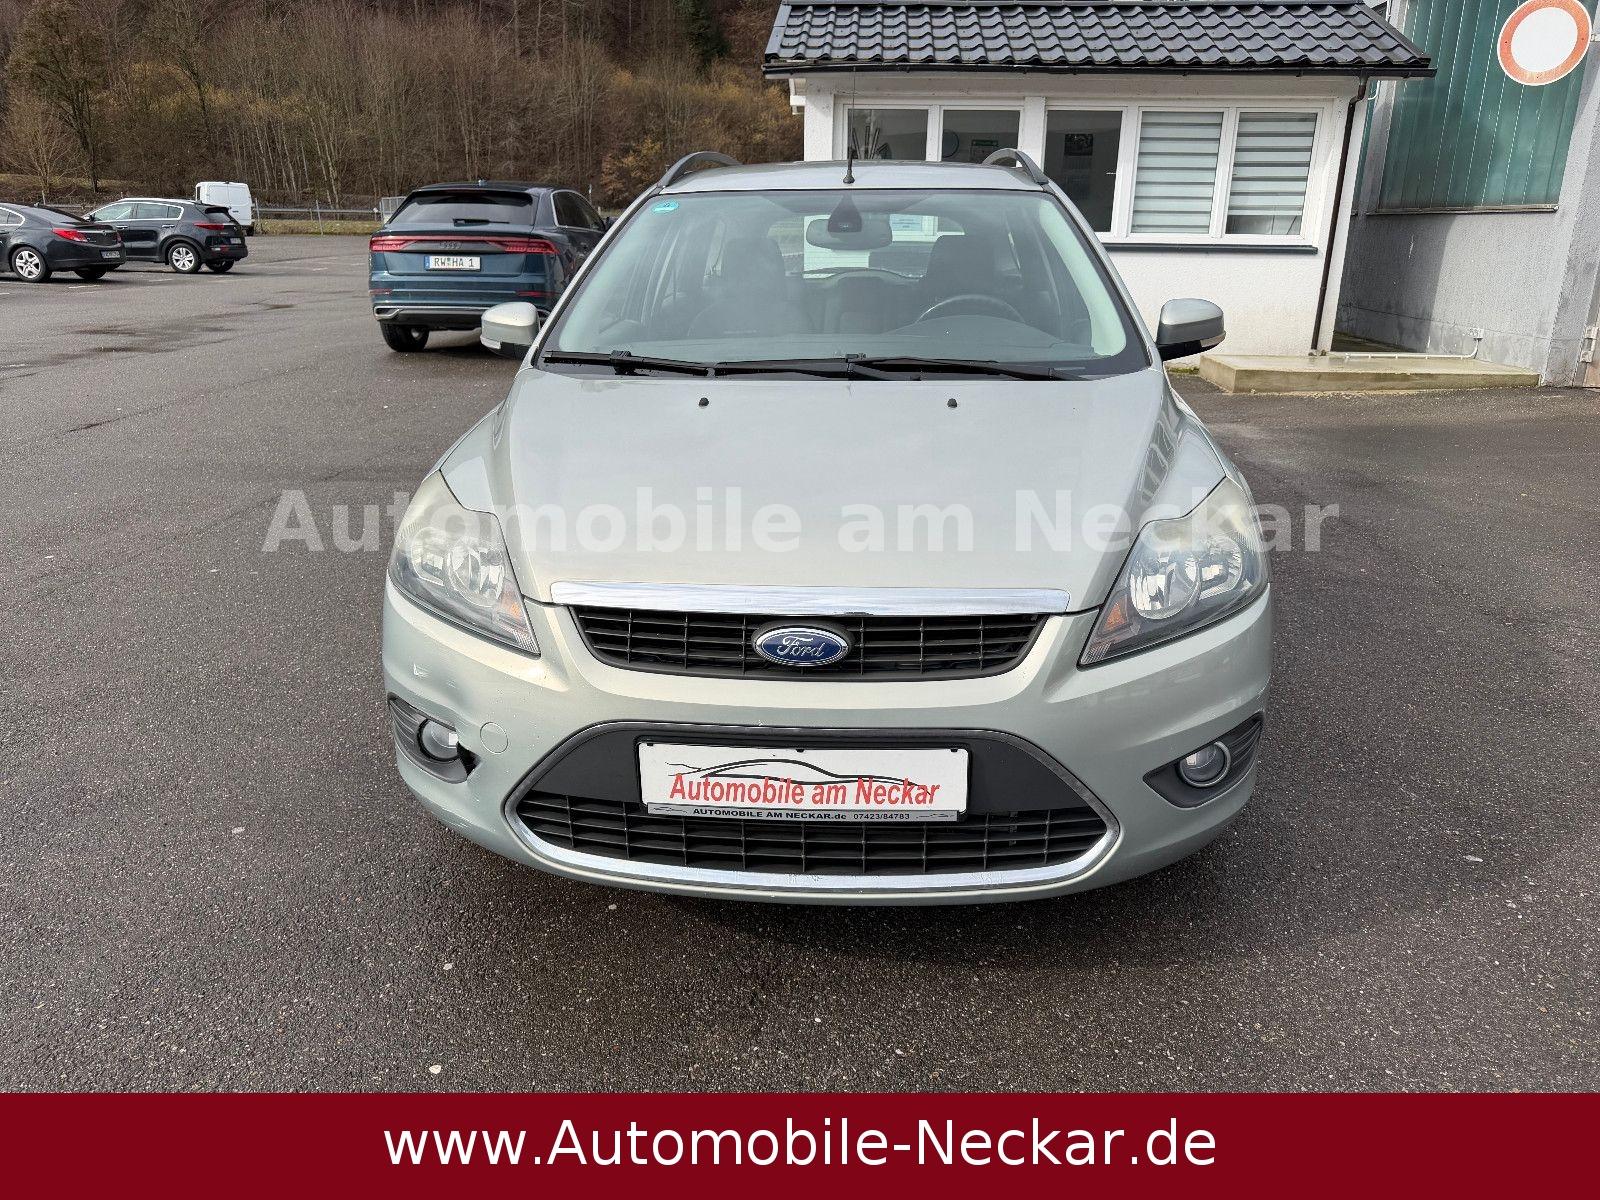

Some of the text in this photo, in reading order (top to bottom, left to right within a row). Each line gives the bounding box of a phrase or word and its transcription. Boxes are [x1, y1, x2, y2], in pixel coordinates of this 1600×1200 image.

[777, 635, 826, 658] Ford
[669, 773, 941, 806] Automobile am Neckar
[693, 808, 763, 818] AUTOMOBILE
[766, 811, 782, 819] AM
[785, 812, 847, 820] NECKAR.de
